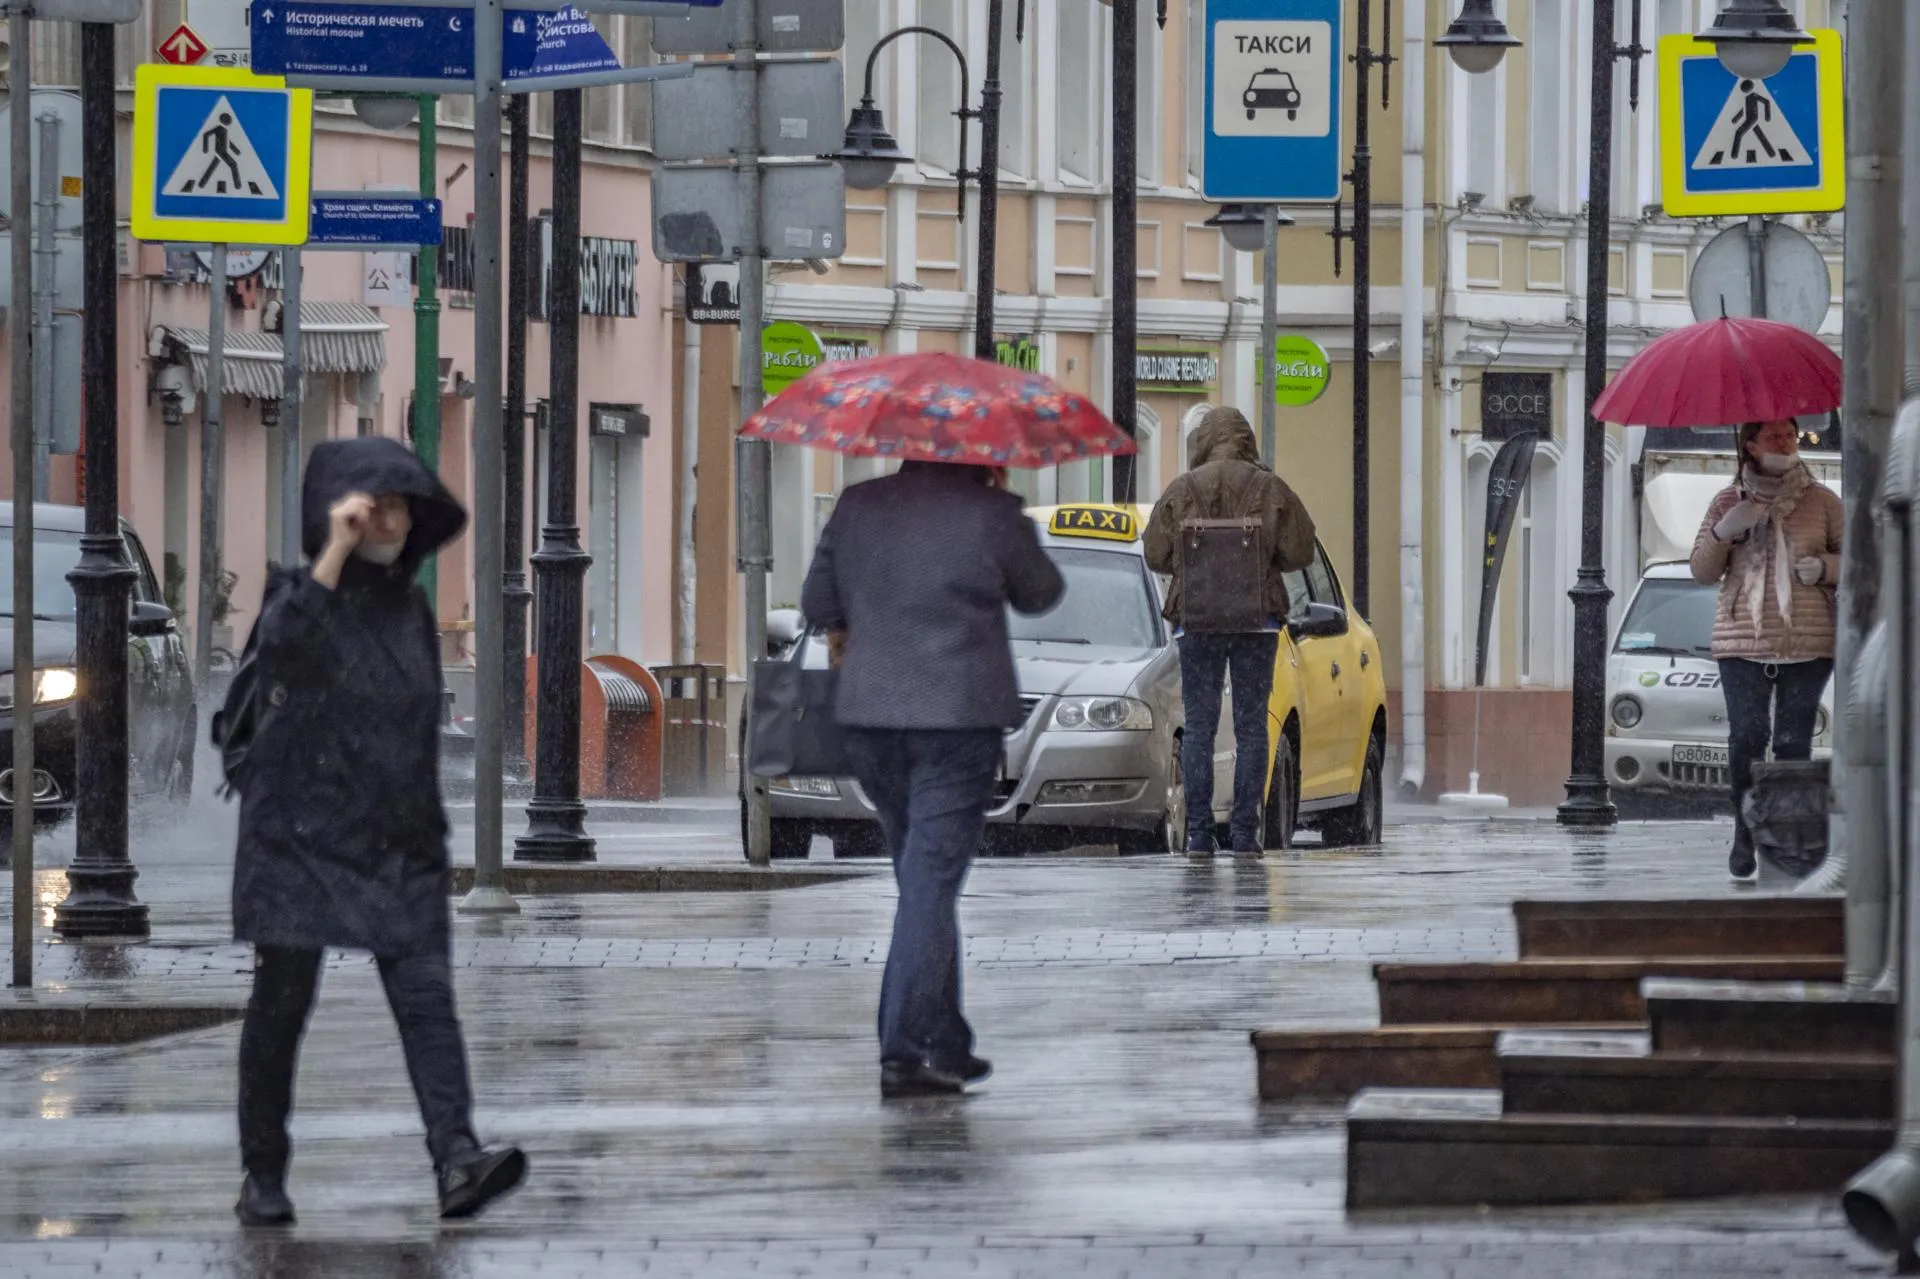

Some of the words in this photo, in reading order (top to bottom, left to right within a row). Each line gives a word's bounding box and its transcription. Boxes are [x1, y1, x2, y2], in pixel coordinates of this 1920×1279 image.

[285, 11, 377, 27] Историческая
[378, 16, 425, 28] мечеть
[285, 26, 329, 37] Historical
[329, 30, 365, 39] mosque
[1234, 35, 1312, 54] ТАКСИ
[323, 203, 346, 212] Храм
[373, 204, 415, 212] Климента
[1487, 394, 1546, 414] ЭССЕ
[1060, 510, 1127, 532] TAXI
